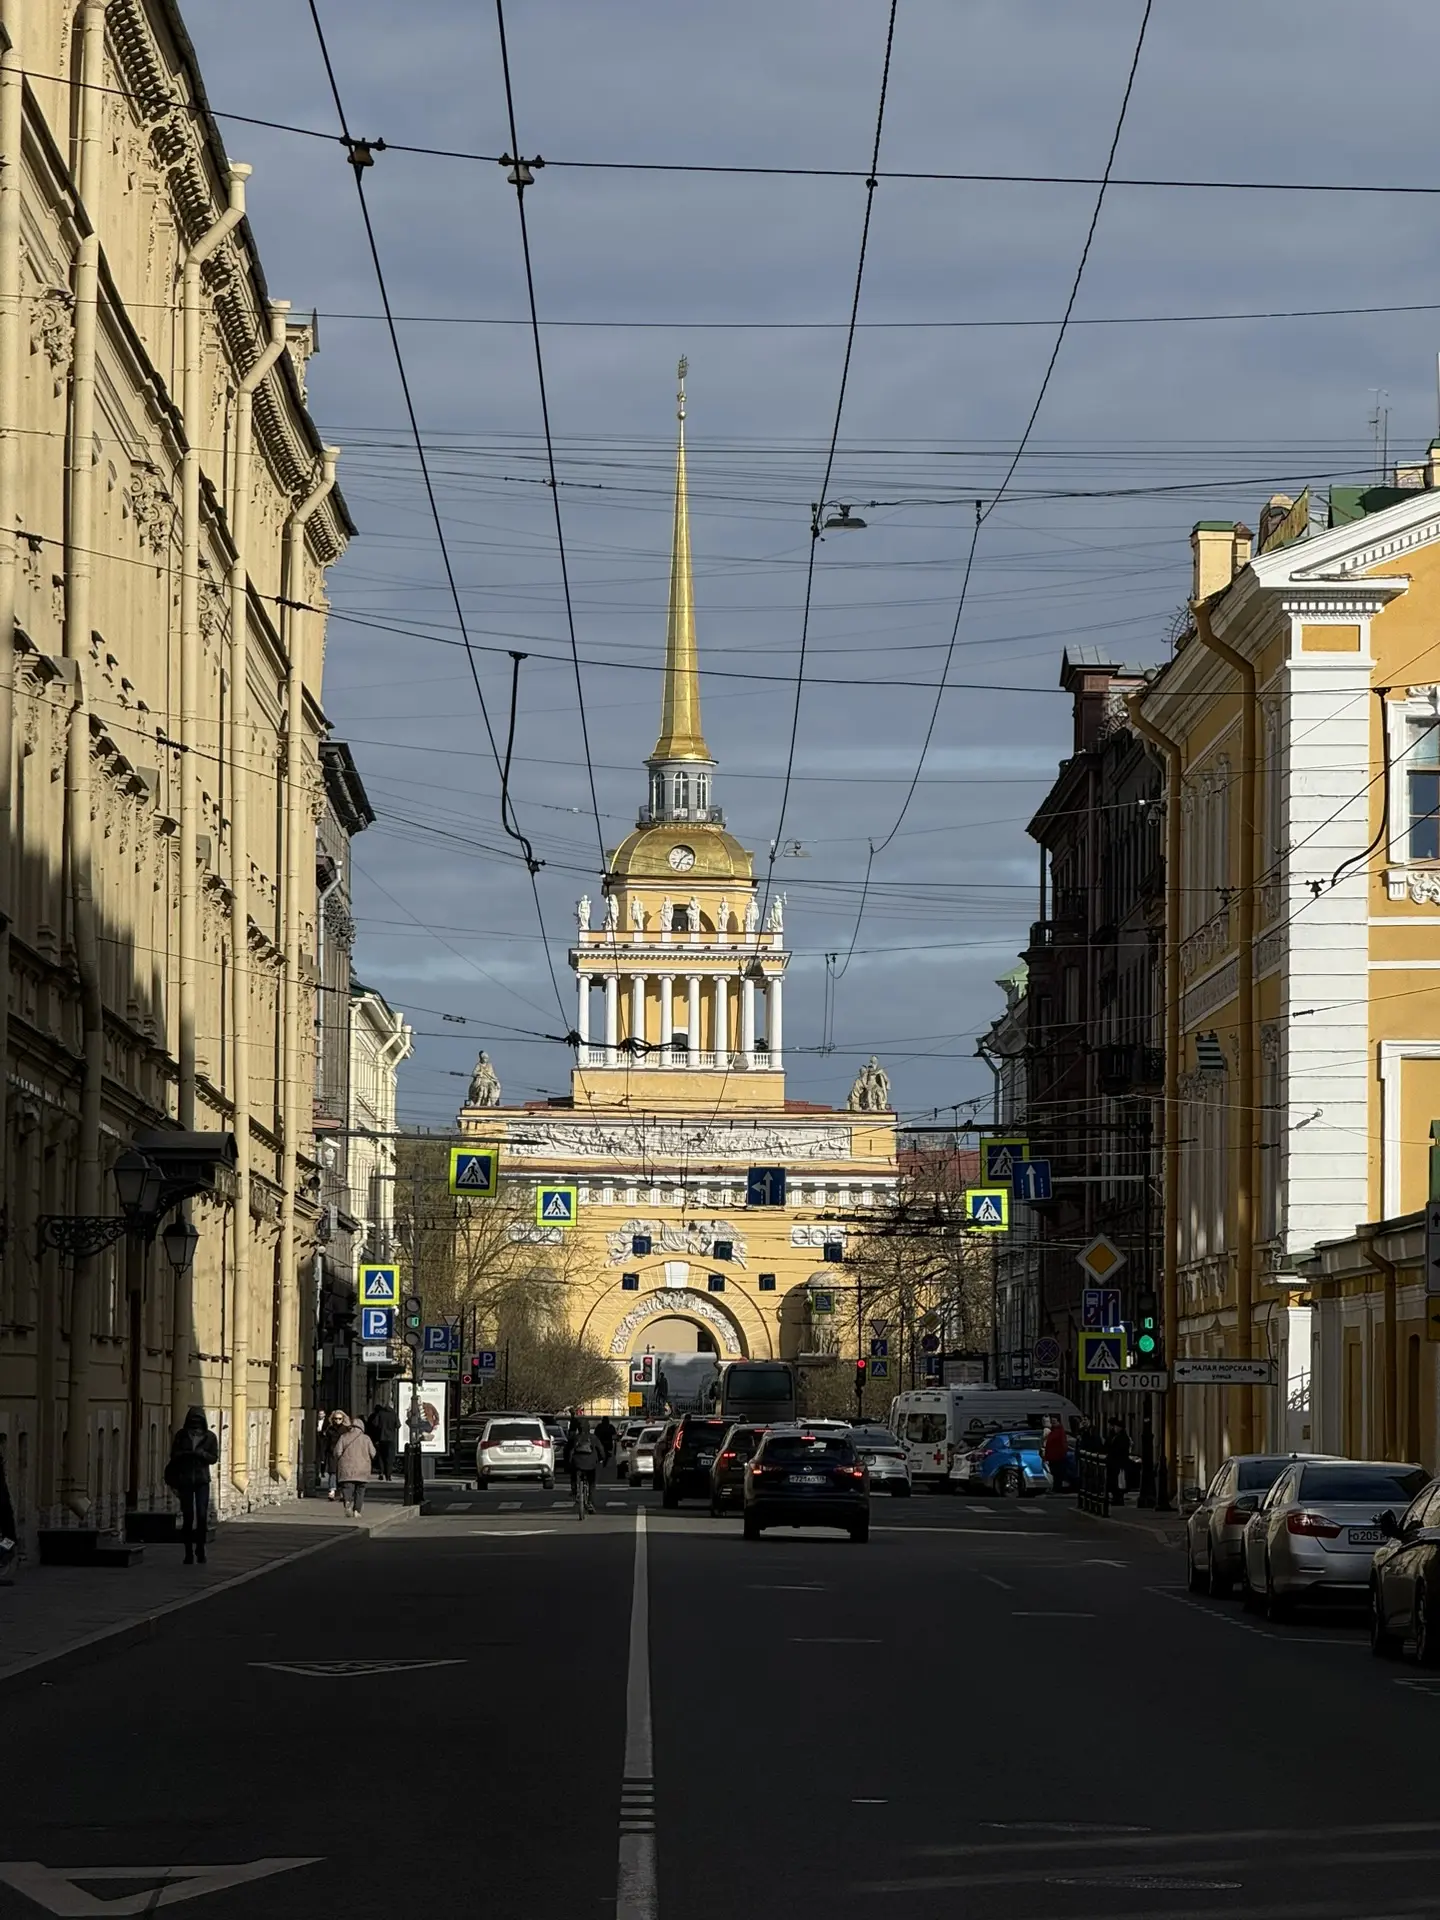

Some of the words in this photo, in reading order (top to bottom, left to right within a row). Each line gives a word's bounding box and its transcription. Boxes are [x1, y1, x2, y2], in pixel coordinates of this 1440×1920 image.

[369, 1311, 387, 1335] P
[1144, 1316, 1153, 1329] 10
[1191, 1364, 1217, 1372] МАЛАЯ
[1219, 1364, 1252, 1372] МОРСКАЯ
[1119, 1375, 1160, 1388] СТОП
[1211, 1373, 1231, 1381] улица
